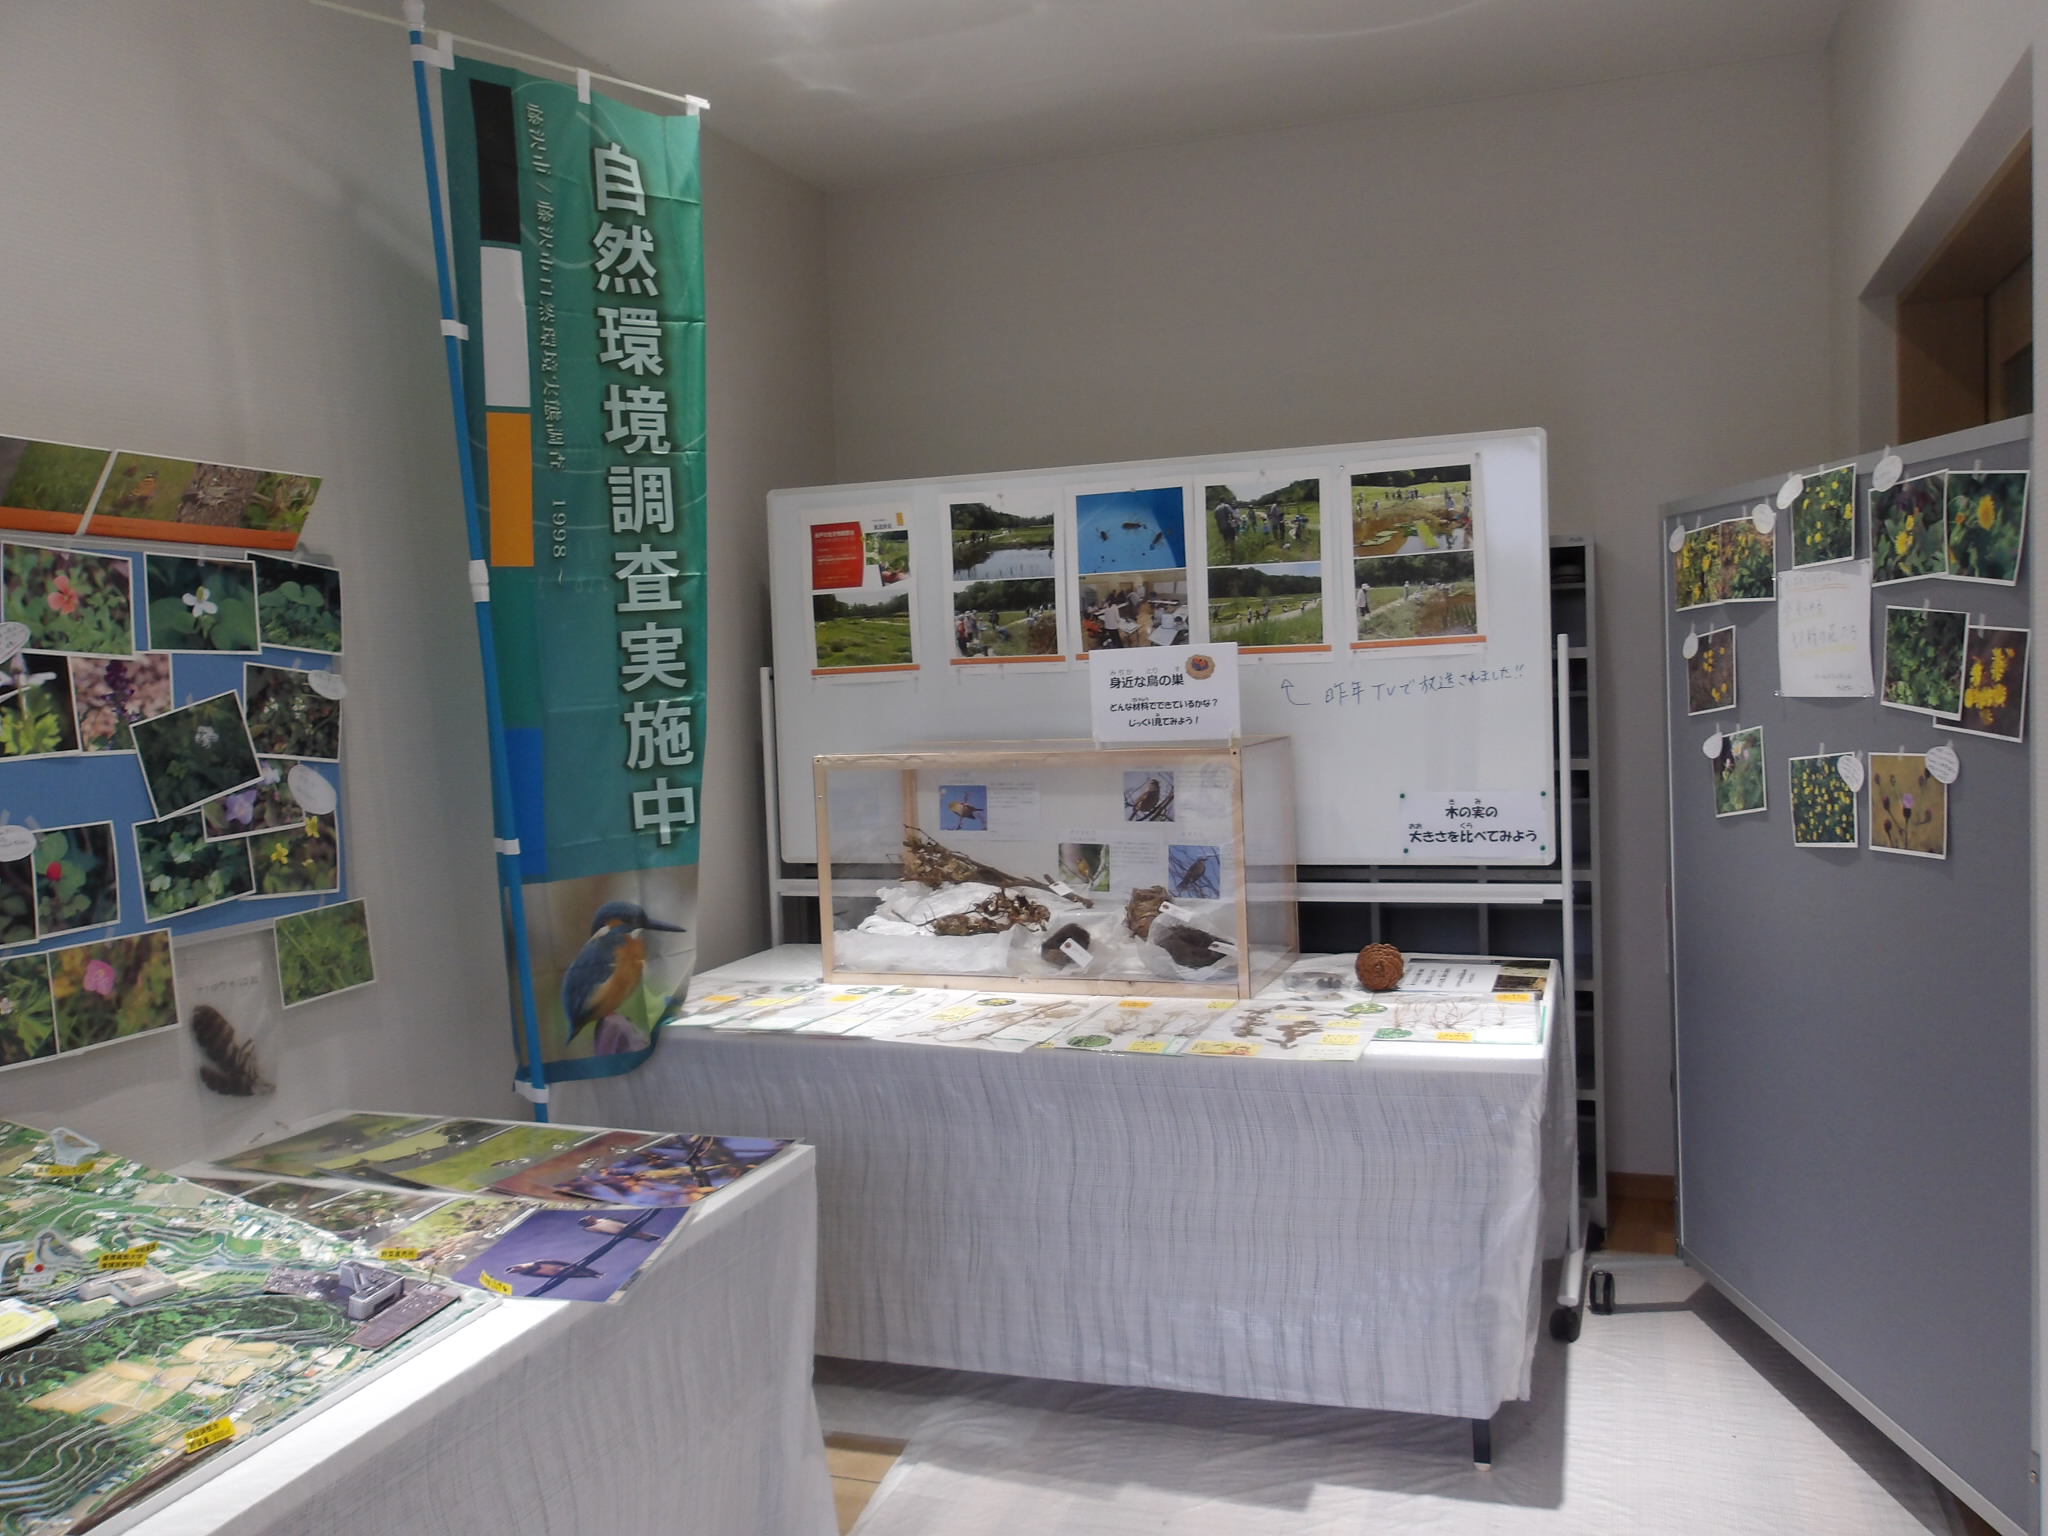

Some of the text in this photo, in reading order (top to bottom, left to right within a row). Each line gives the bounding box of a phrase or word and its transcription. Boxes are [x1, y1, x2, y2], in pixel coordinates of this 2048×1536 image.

[592, 142, 696, 845] 自然環境調査実施中
[1109, 673, 1184, 689] 身近な鳥の巣
[1445, 806, 1498, 820] 木の実の
[1409, 830, 1537, 843] 大きさを比べてみよう
